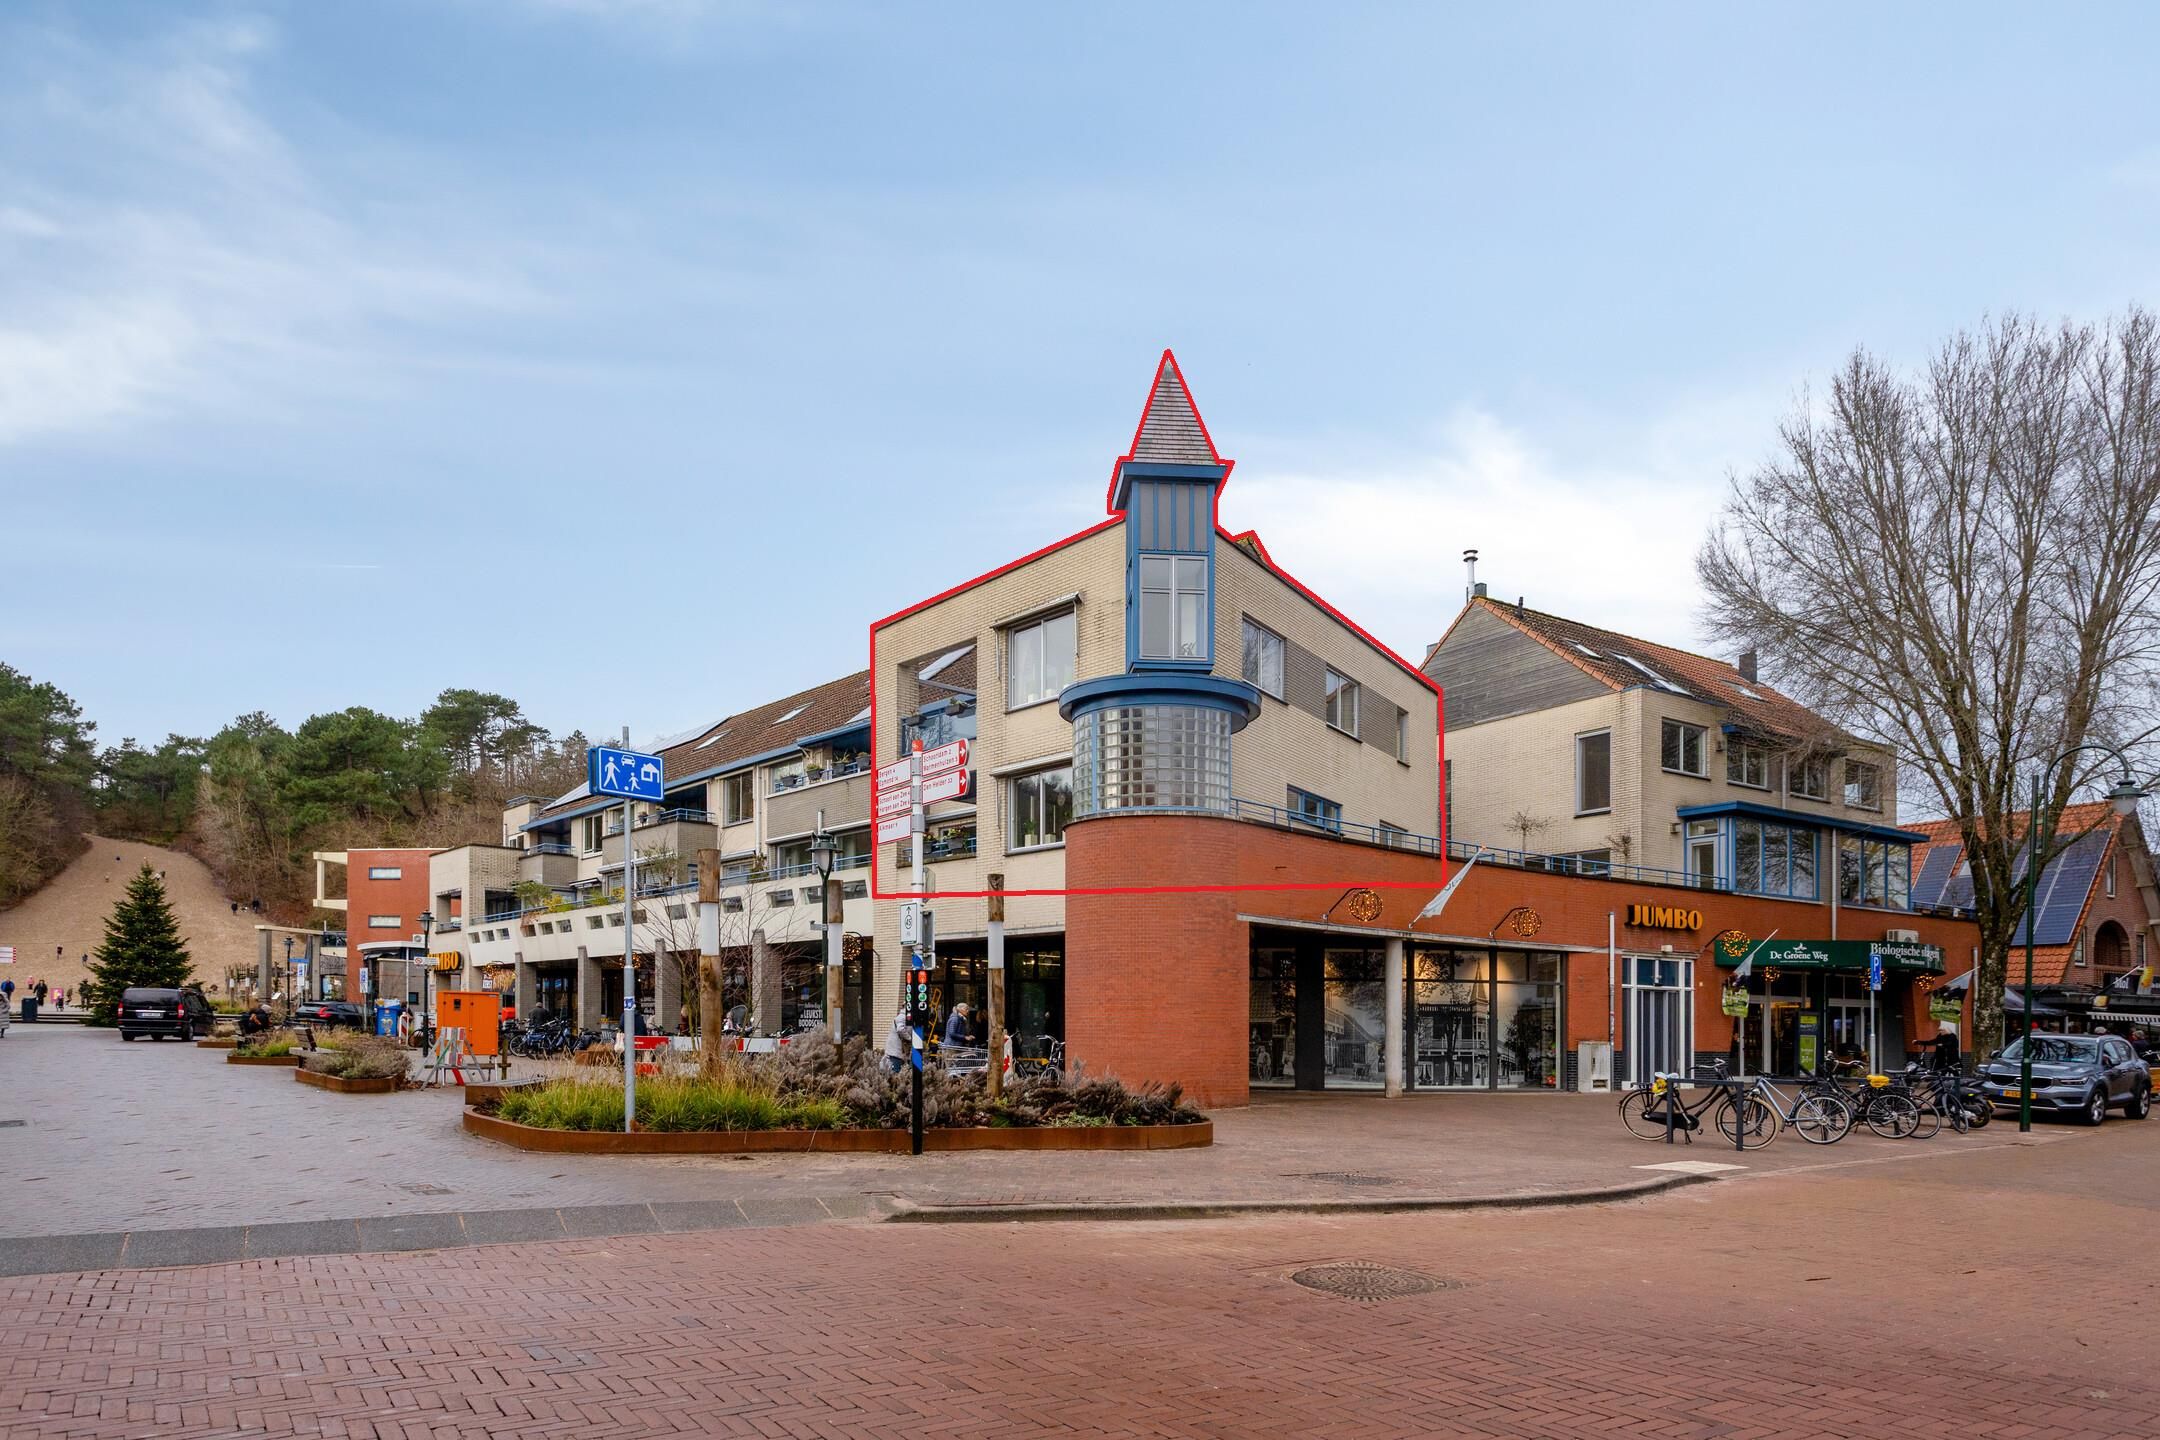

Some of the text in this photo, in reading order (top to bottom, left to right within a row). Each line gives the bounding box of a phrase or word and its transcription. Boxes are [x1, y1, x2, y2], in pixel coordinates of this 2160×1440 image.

[1631, 904, 1703, 930] JUMBO
[1770, 950, 1829, 962] De Groene Weg
[1871, 943, 1920, 959] Biologische
